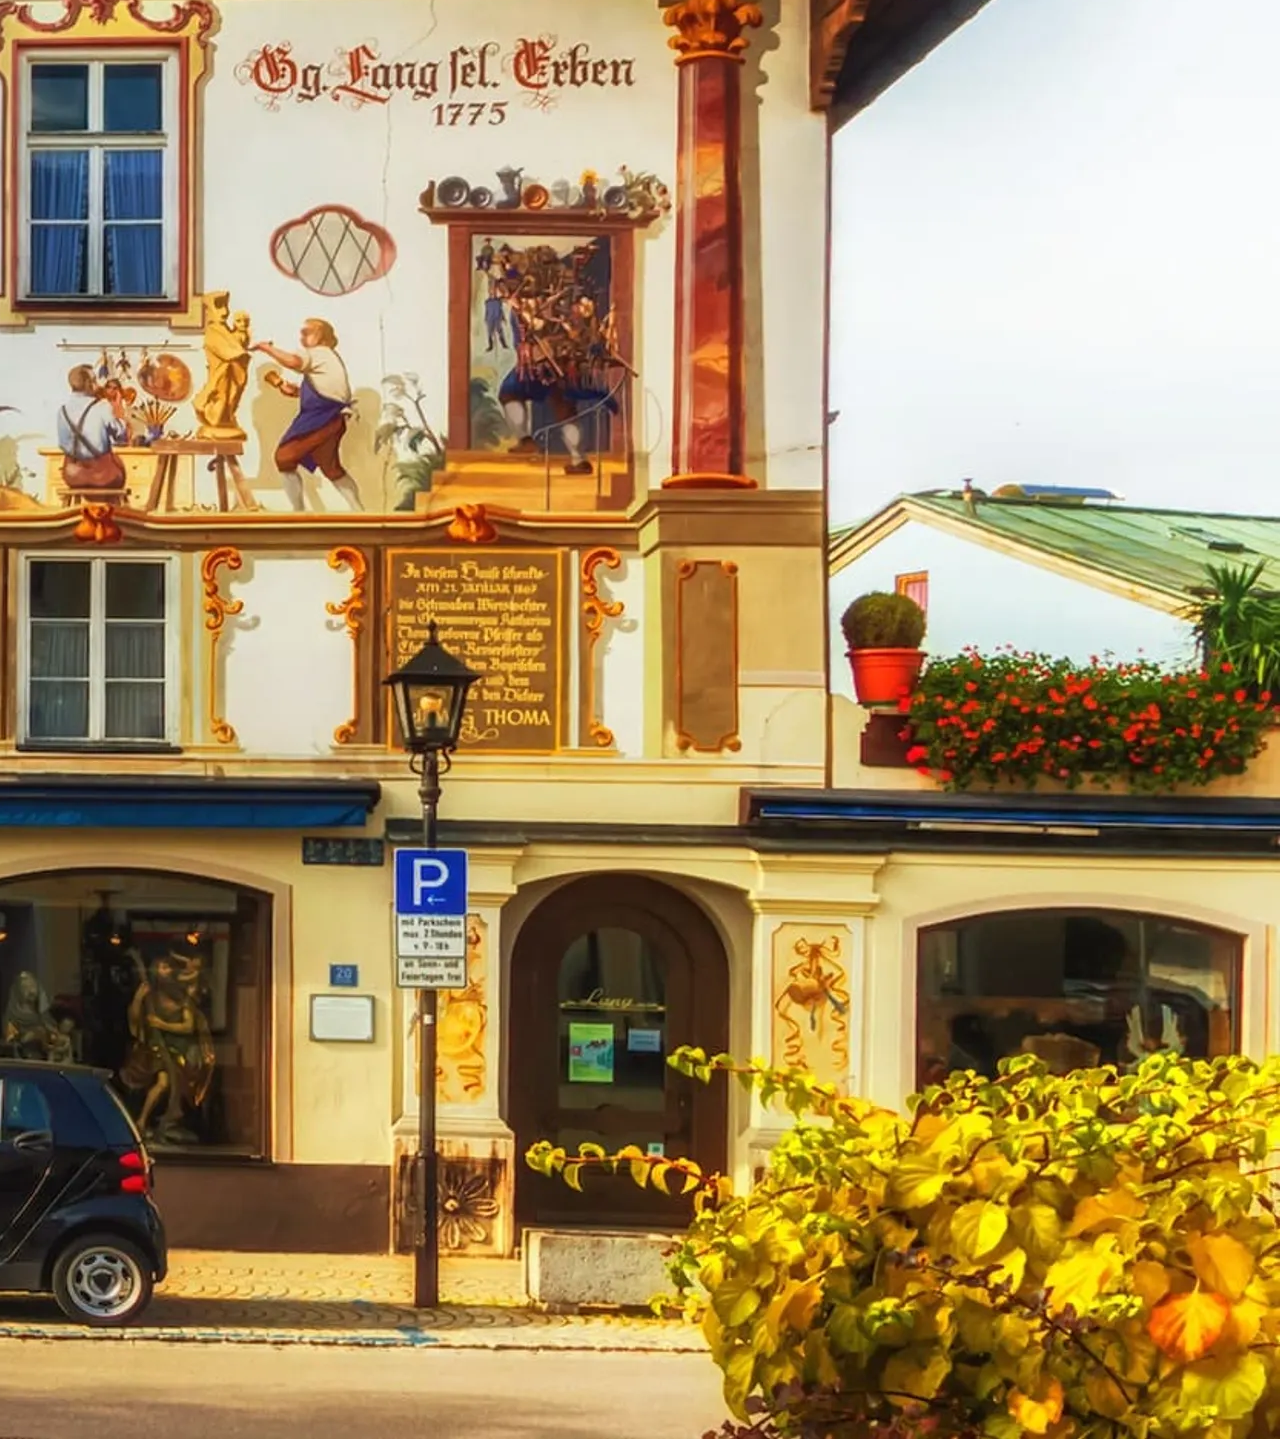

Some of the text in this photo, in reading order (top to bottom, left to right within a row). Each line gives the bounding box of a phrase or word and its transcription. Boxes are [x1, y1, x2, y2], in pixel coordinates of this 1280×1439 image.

[331, 39, 439, 105] Lang
[506, 35, 636, 108] Erben
[433, 102, 509, 126] 1775
[485, 708, 551, 726] THOMA
[413, 858, 449, 906] P
